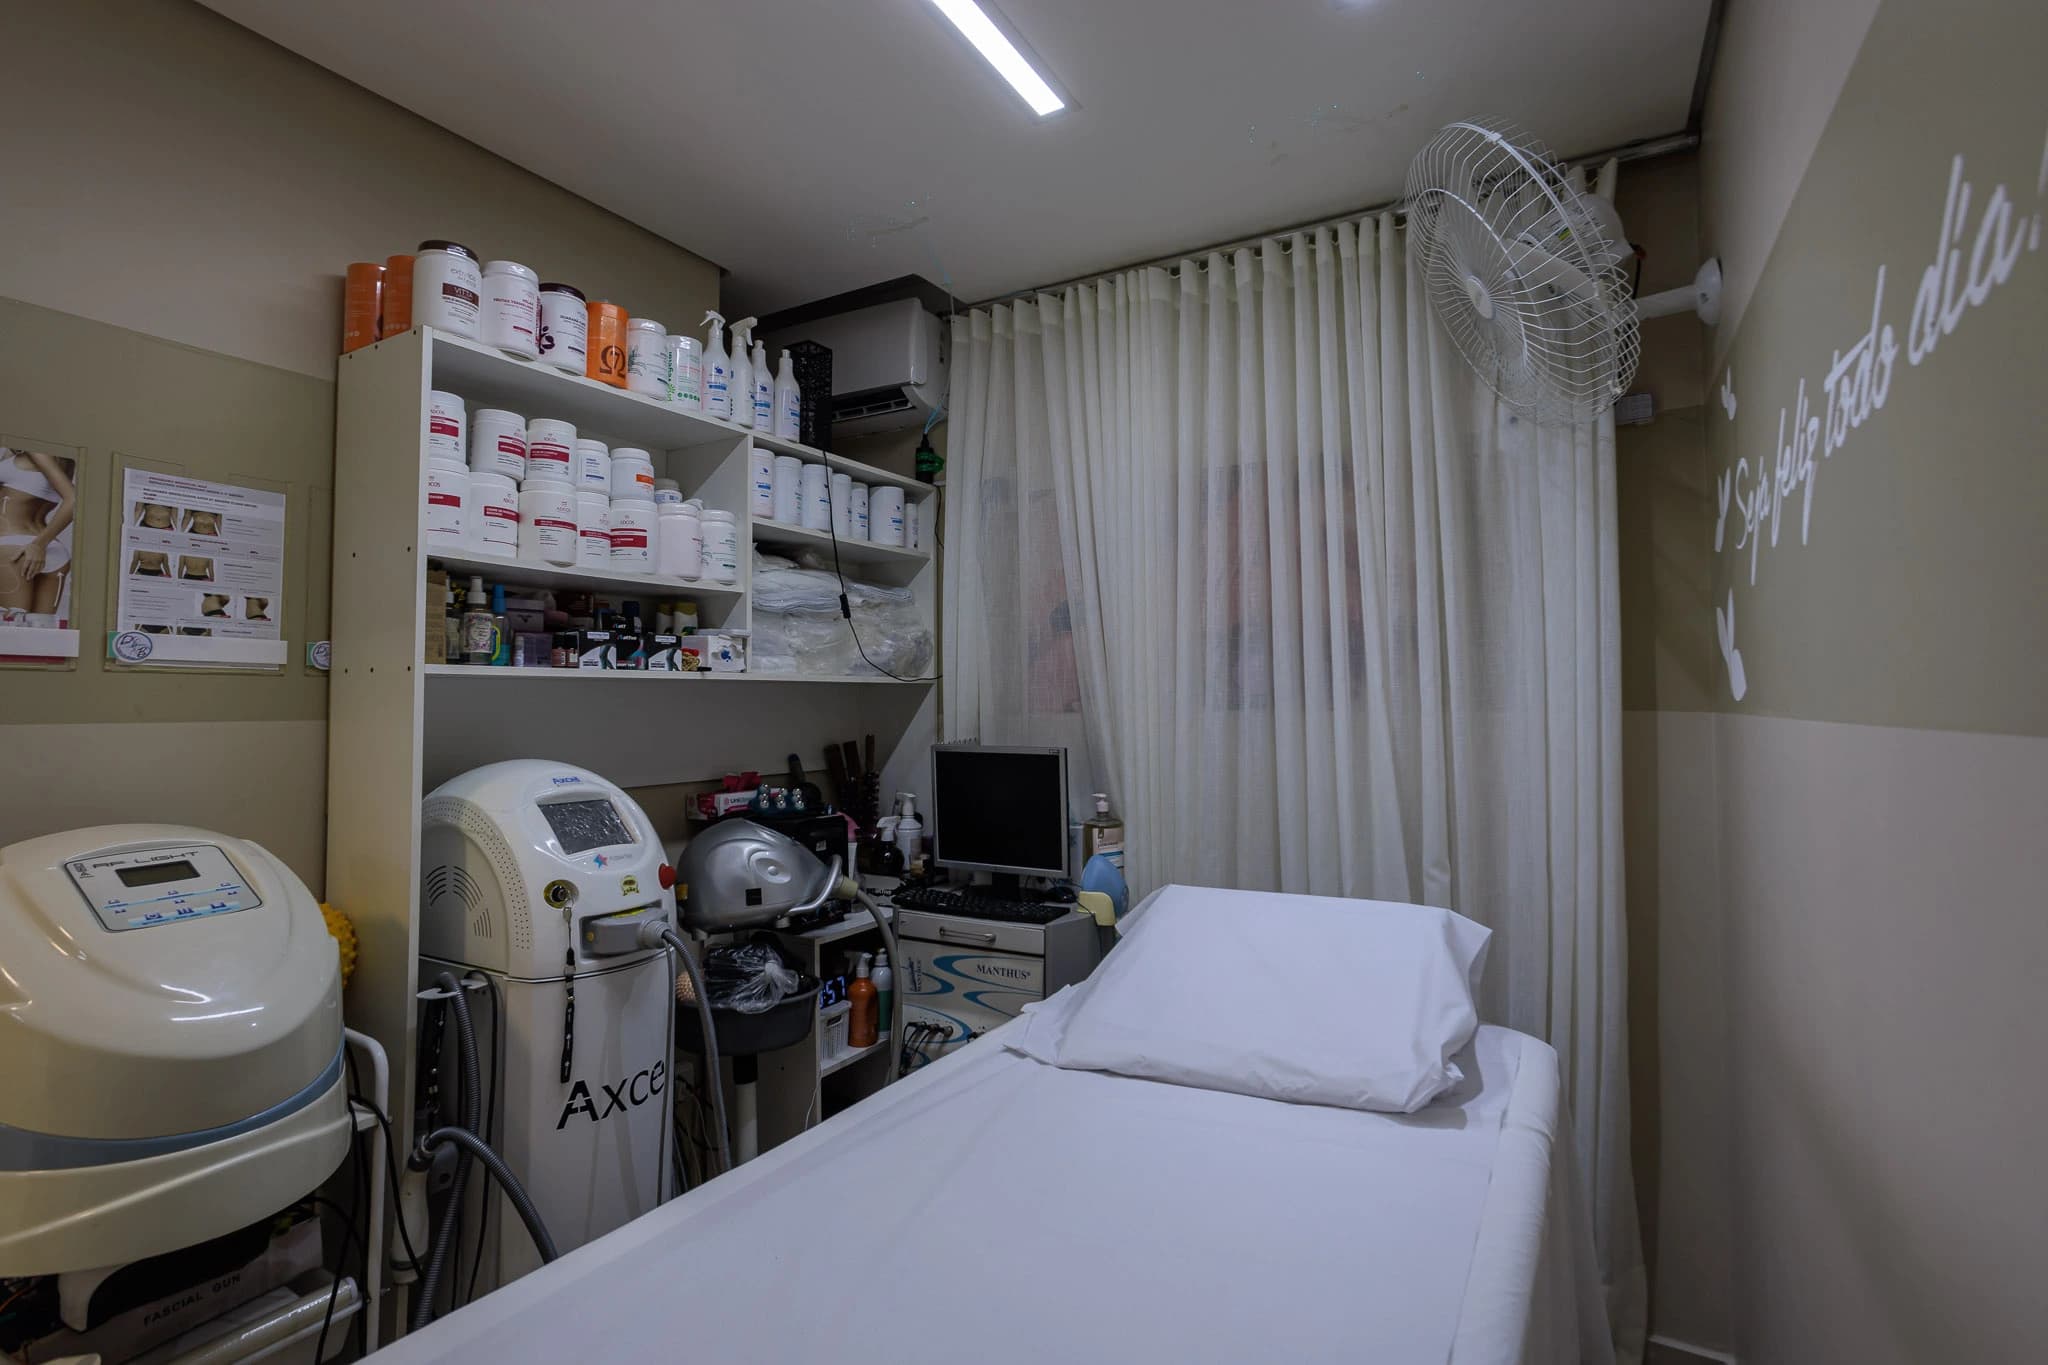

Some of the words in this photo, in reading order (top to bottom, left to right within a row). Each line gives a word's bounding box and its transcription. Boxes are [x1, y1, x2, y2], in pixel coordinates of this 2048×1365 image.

[1735, 456, 1771, 586] Seja
[1771, 378, 1820, 548] feliz
[1823, 264, 1899, 458] todo
[136, 851, 200, 865] LIGHT
[556, 1059, 667, 1131] Axce
[144, 1292, 204, 1328] FASCIAL
[211, 1273, 241, 1294] GUN
